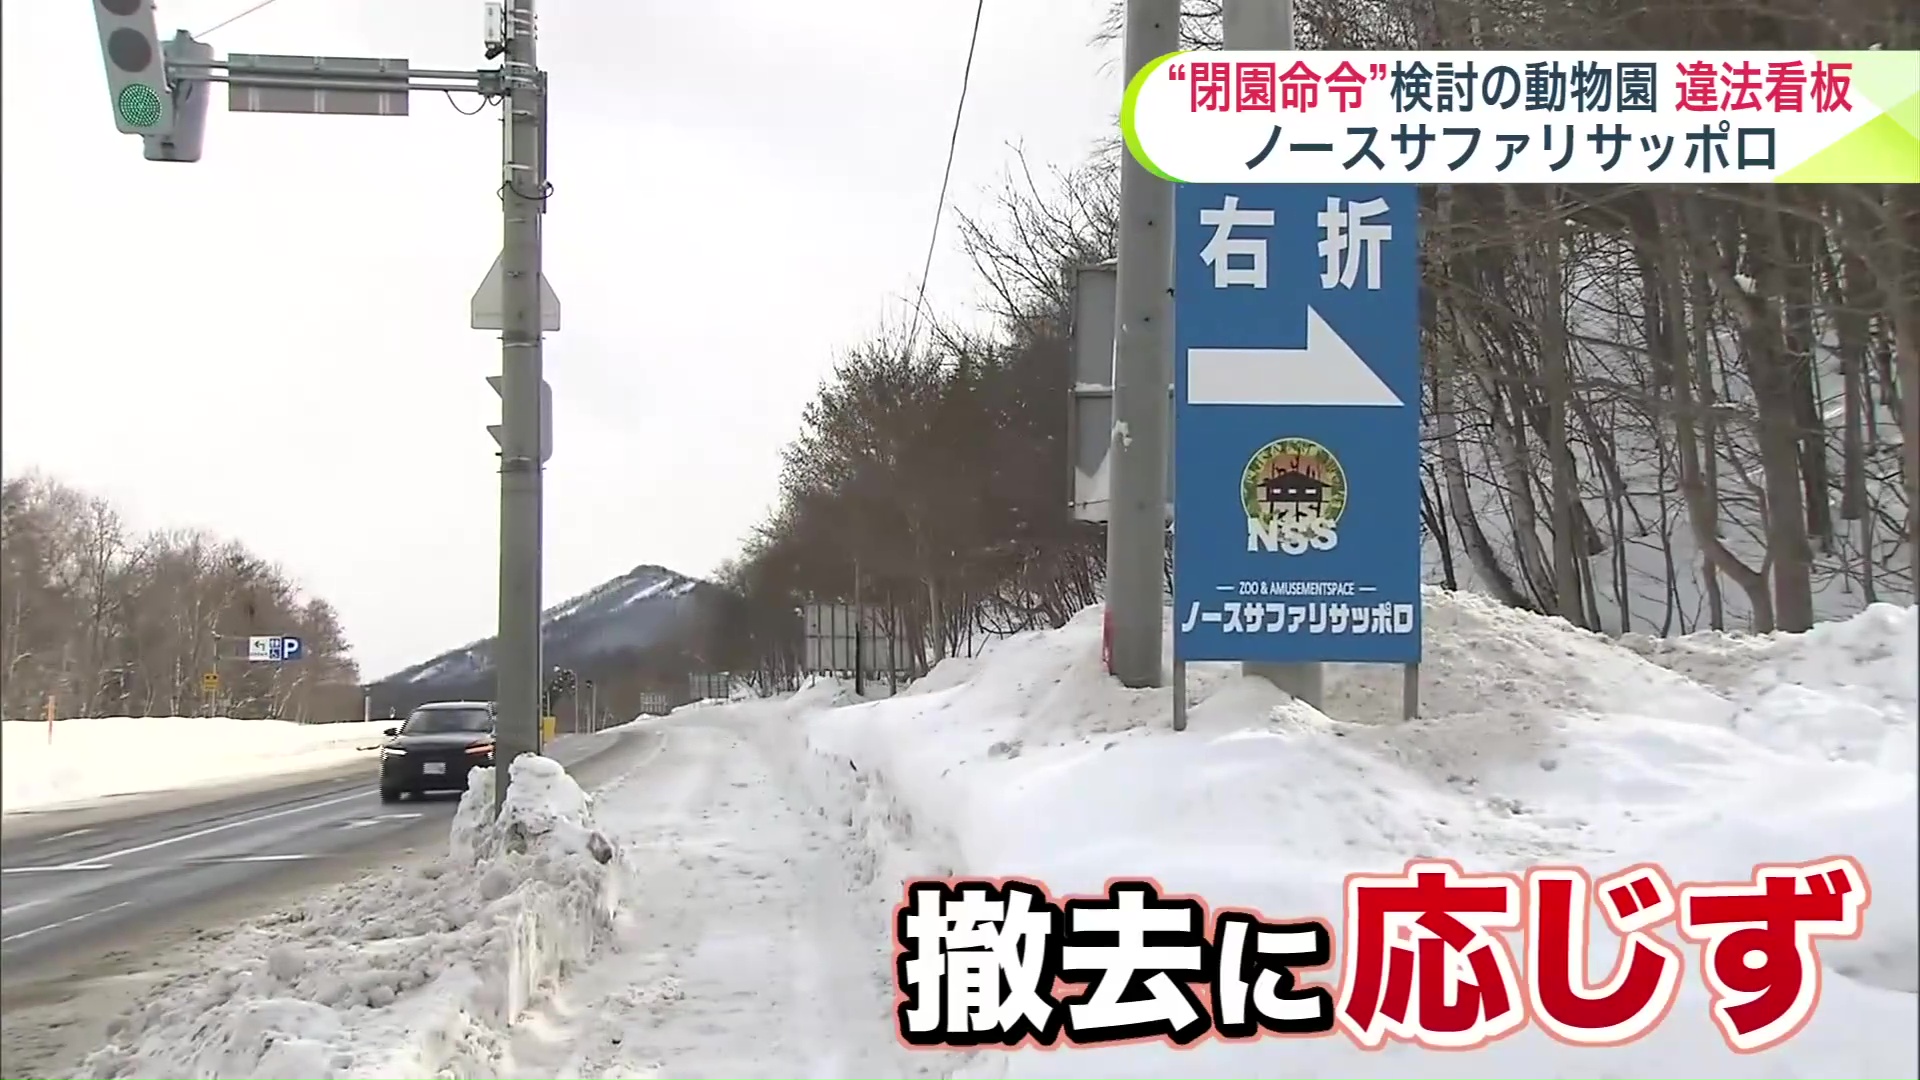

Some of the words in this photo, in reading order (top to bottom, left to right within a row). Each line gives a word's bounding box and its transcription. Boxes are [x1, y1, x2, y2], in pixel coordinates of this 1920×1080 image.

[1247, 516, 1338, 555] NSS
[1239, 581, 1259, 596] ZOO
[1260, 581, 1268, 595] &
[1269, 582, 1355, 596] AMUSEMENTSPACE
[1181, 601, 1414, 635] ノースサファリサッポロ
[283, 638, 299, 659] P
